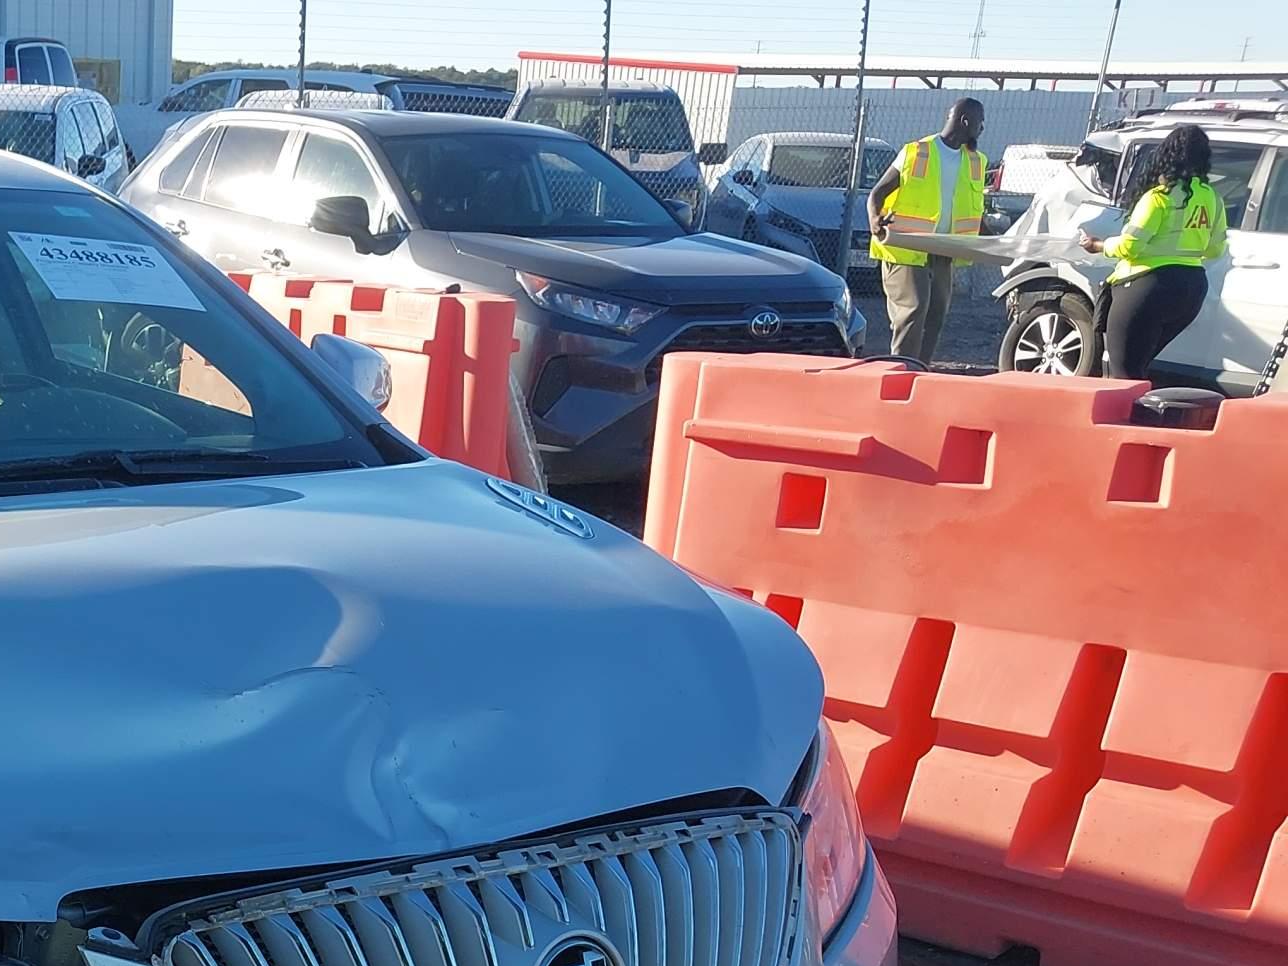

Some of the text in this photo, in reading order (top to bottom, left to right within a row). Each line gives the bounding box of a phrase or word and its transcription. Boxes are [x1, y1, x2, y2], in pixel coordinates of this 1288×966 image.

[1118, 90, 1155, 108] K J
[40, 247, 156, 268] 43488185
